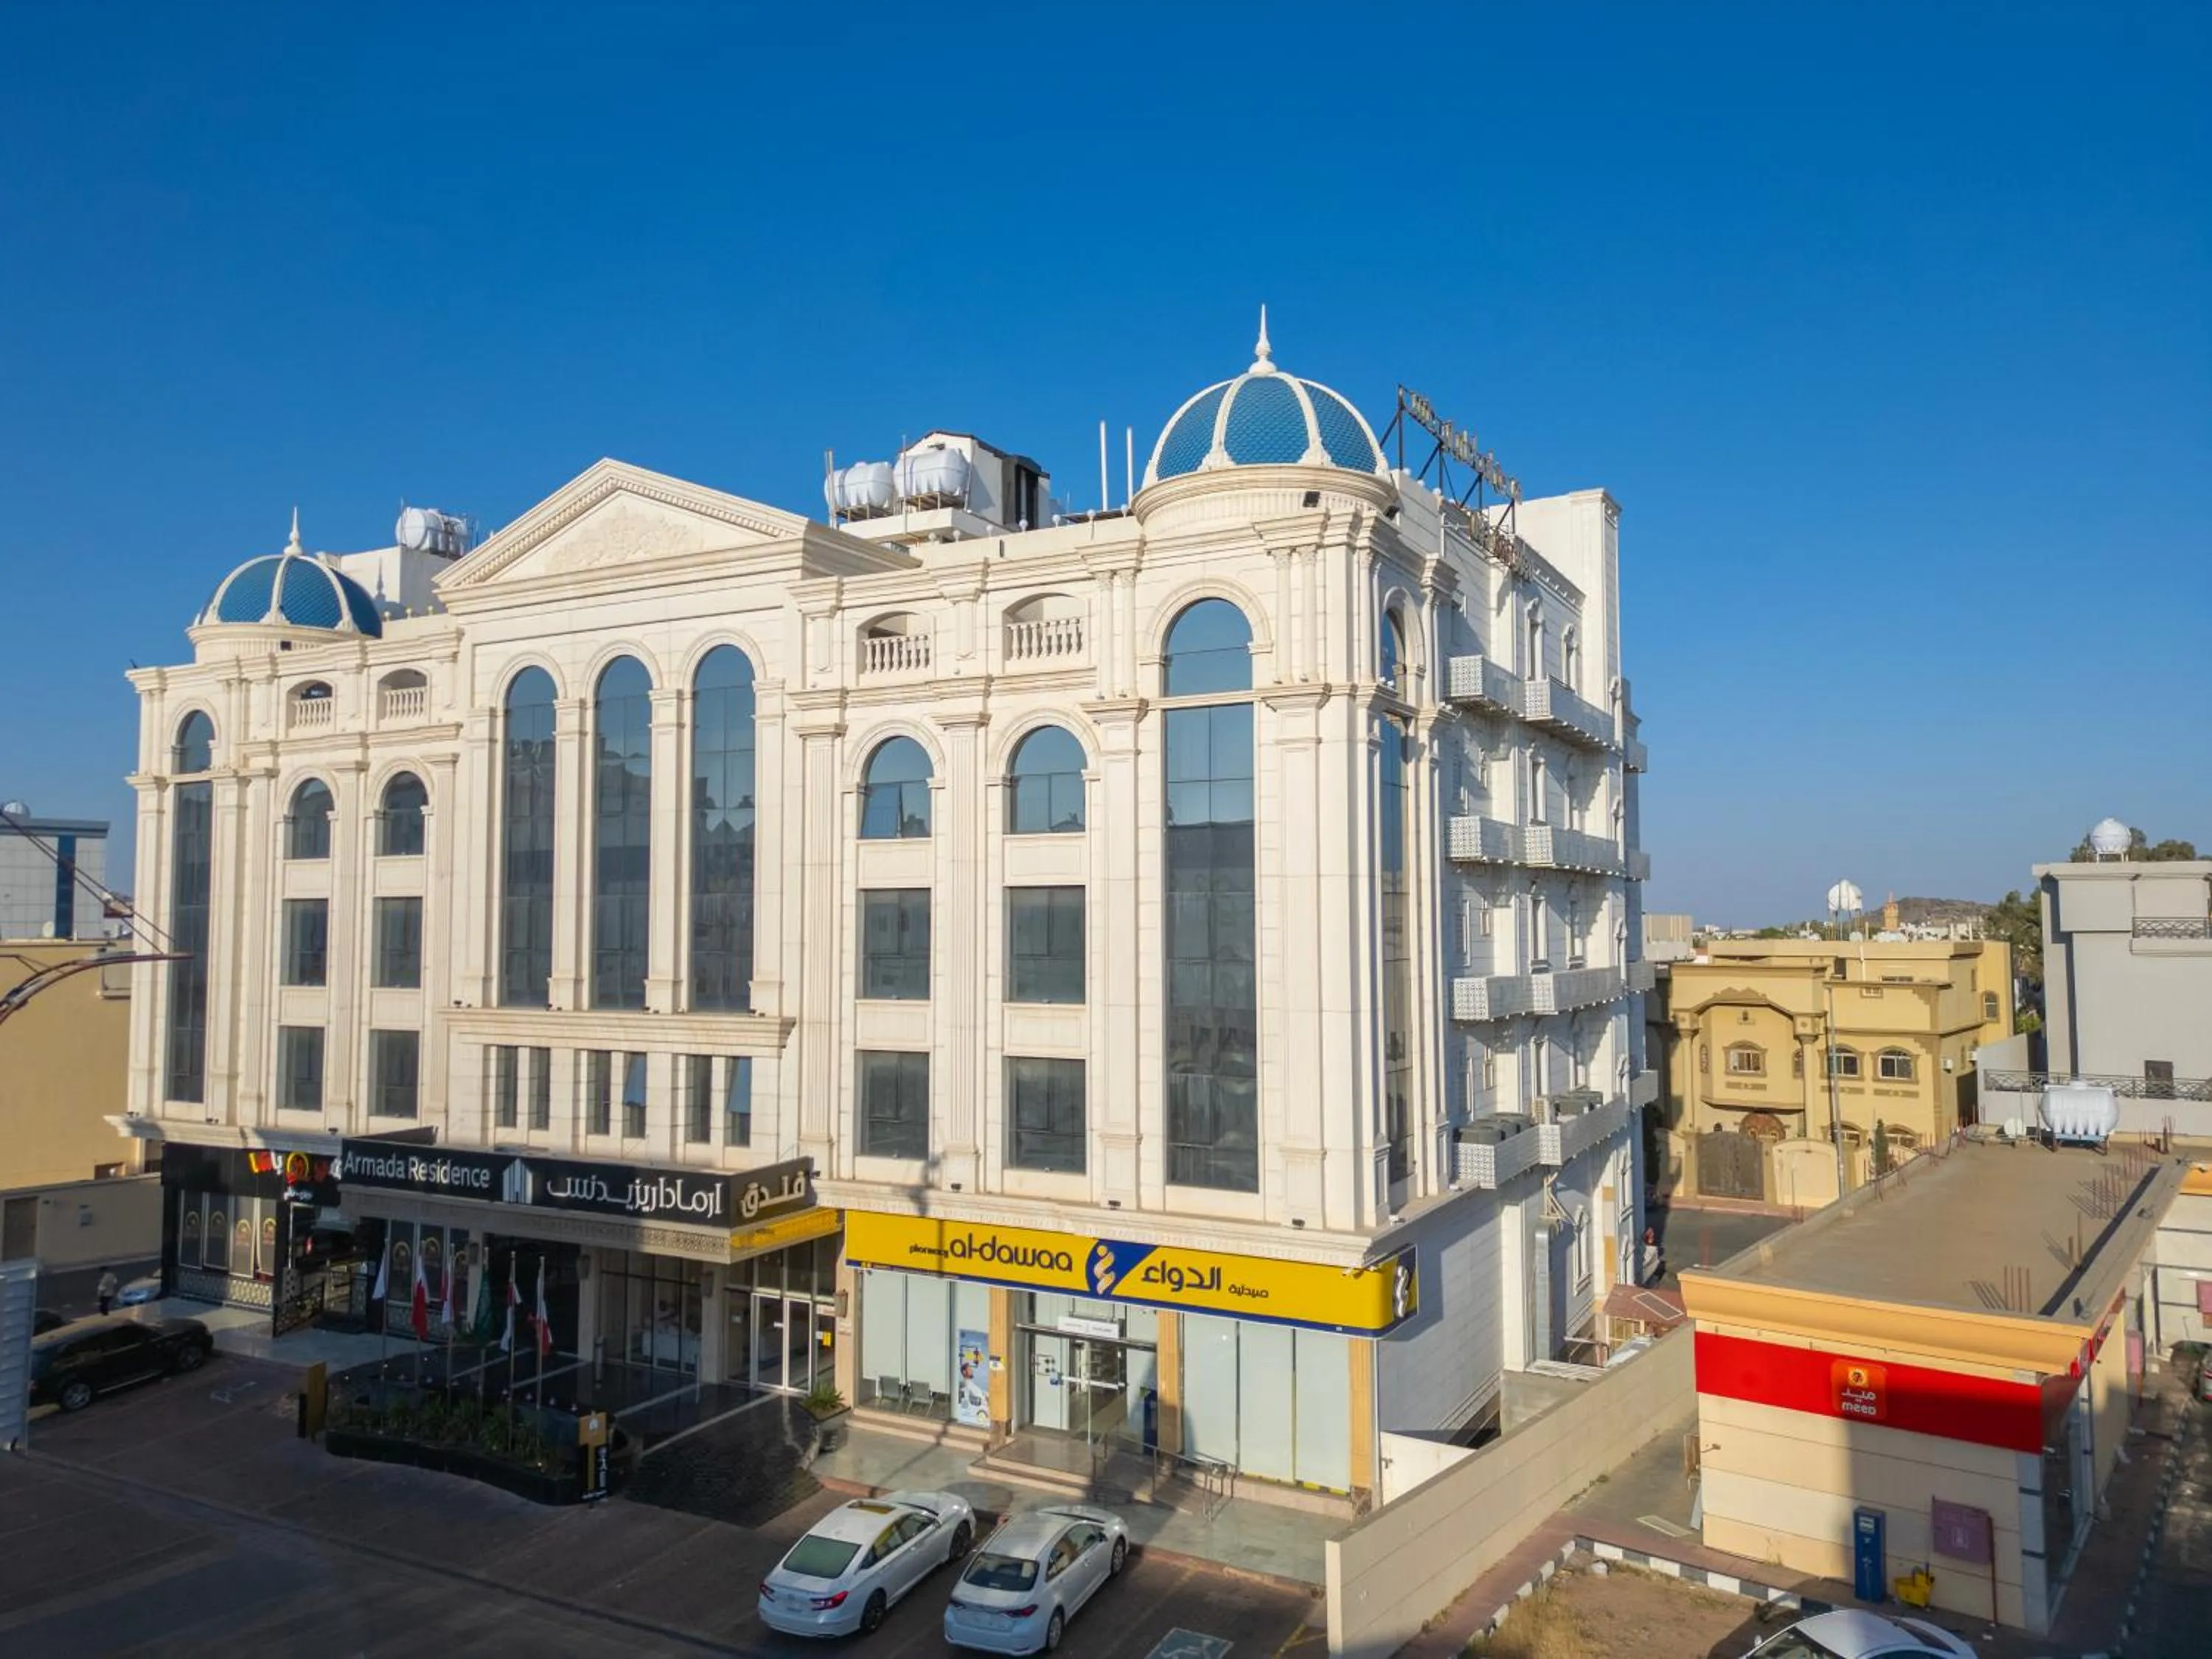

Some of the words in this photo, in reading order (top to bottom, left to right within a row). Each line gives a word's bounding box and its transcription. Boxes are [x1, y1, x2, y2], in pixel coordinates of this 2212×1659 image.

[344, 1150, 405, 1179] Armada
[408, 1156, 491, 1188] Residence
[740, 1171, 805, 1218] فندق
[949, 1233, 1073, 1272] al-dawaa
[1141, 1259, 1221, 1292] الدواء
[1840, 1387, 1876, 1402] ميد
